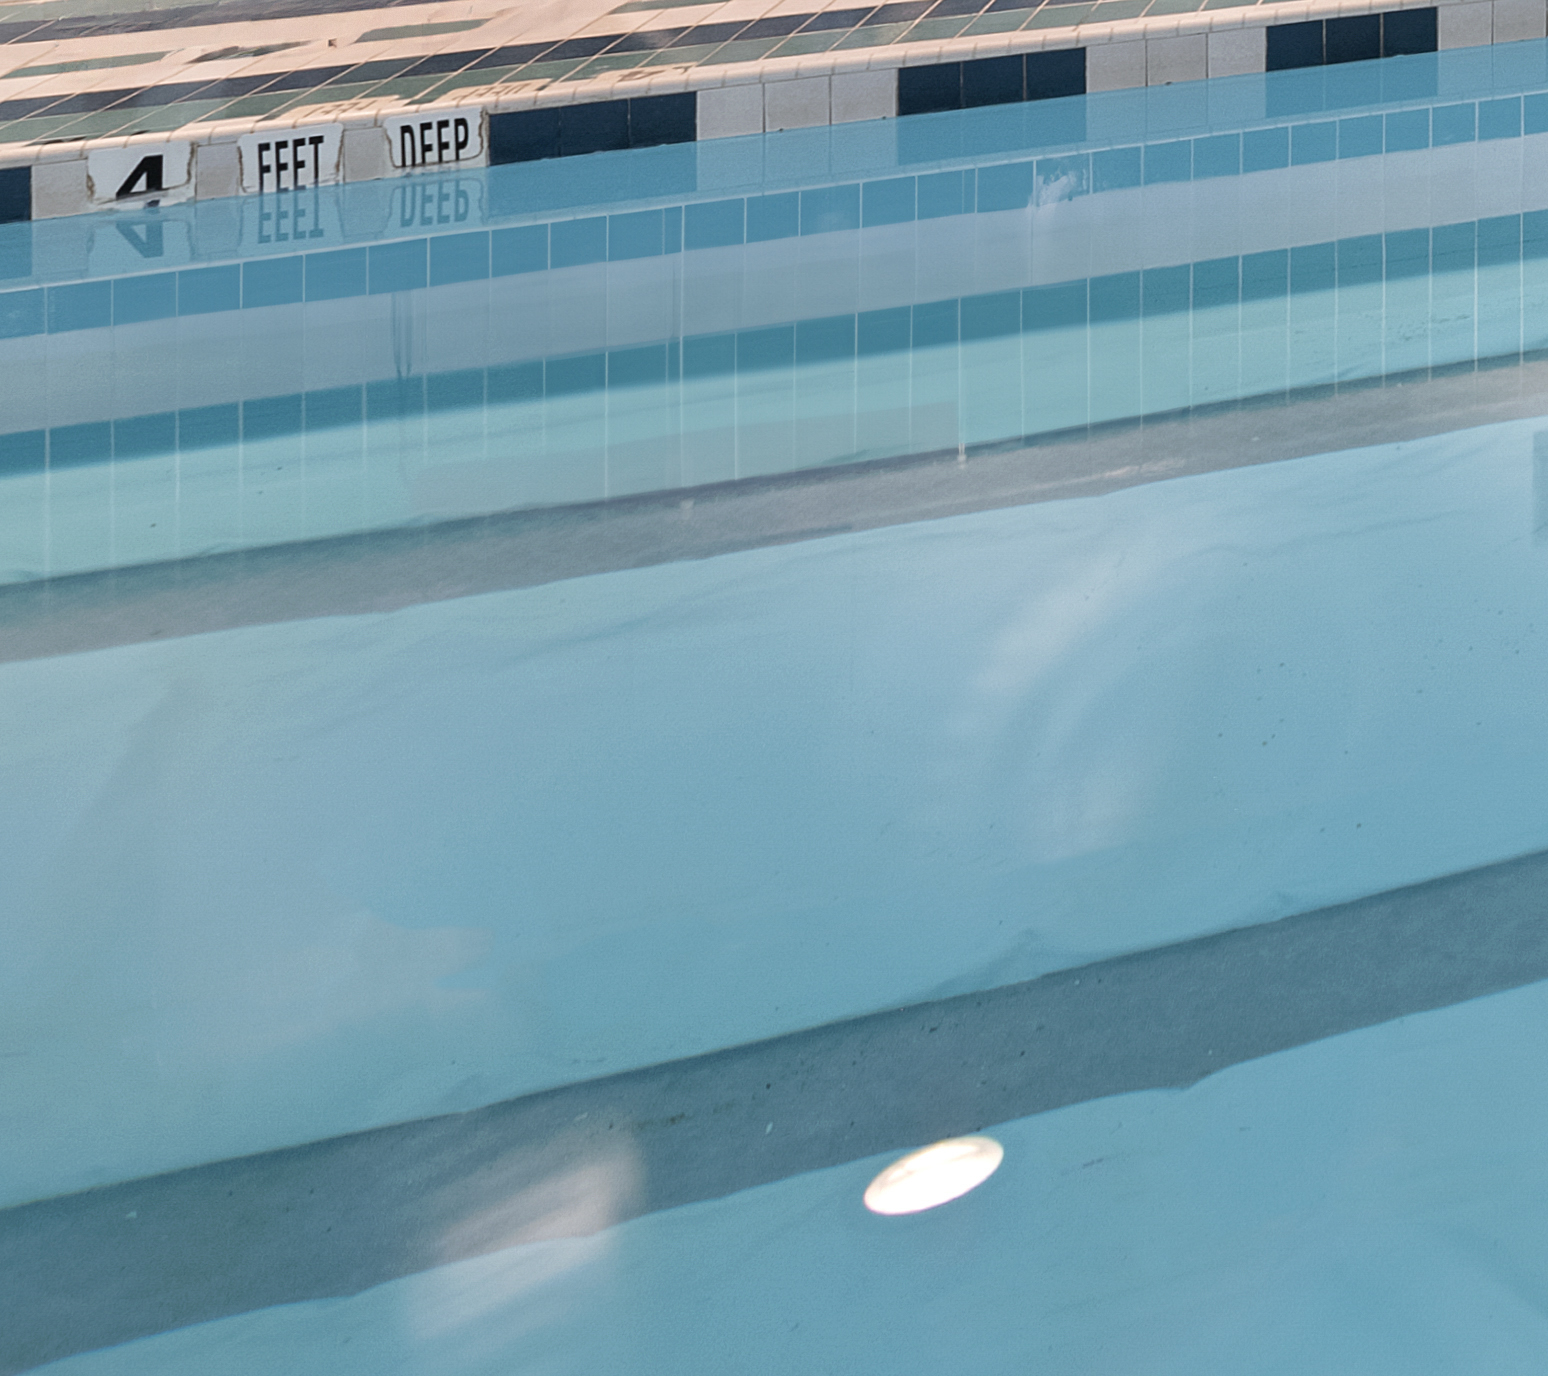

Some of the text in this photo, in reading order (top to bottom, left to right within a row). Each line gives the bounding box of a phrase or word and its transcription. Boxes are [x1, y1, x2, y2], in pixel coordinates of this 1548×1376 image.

[116, 117, 470, 207] 4 FEET DEEP
